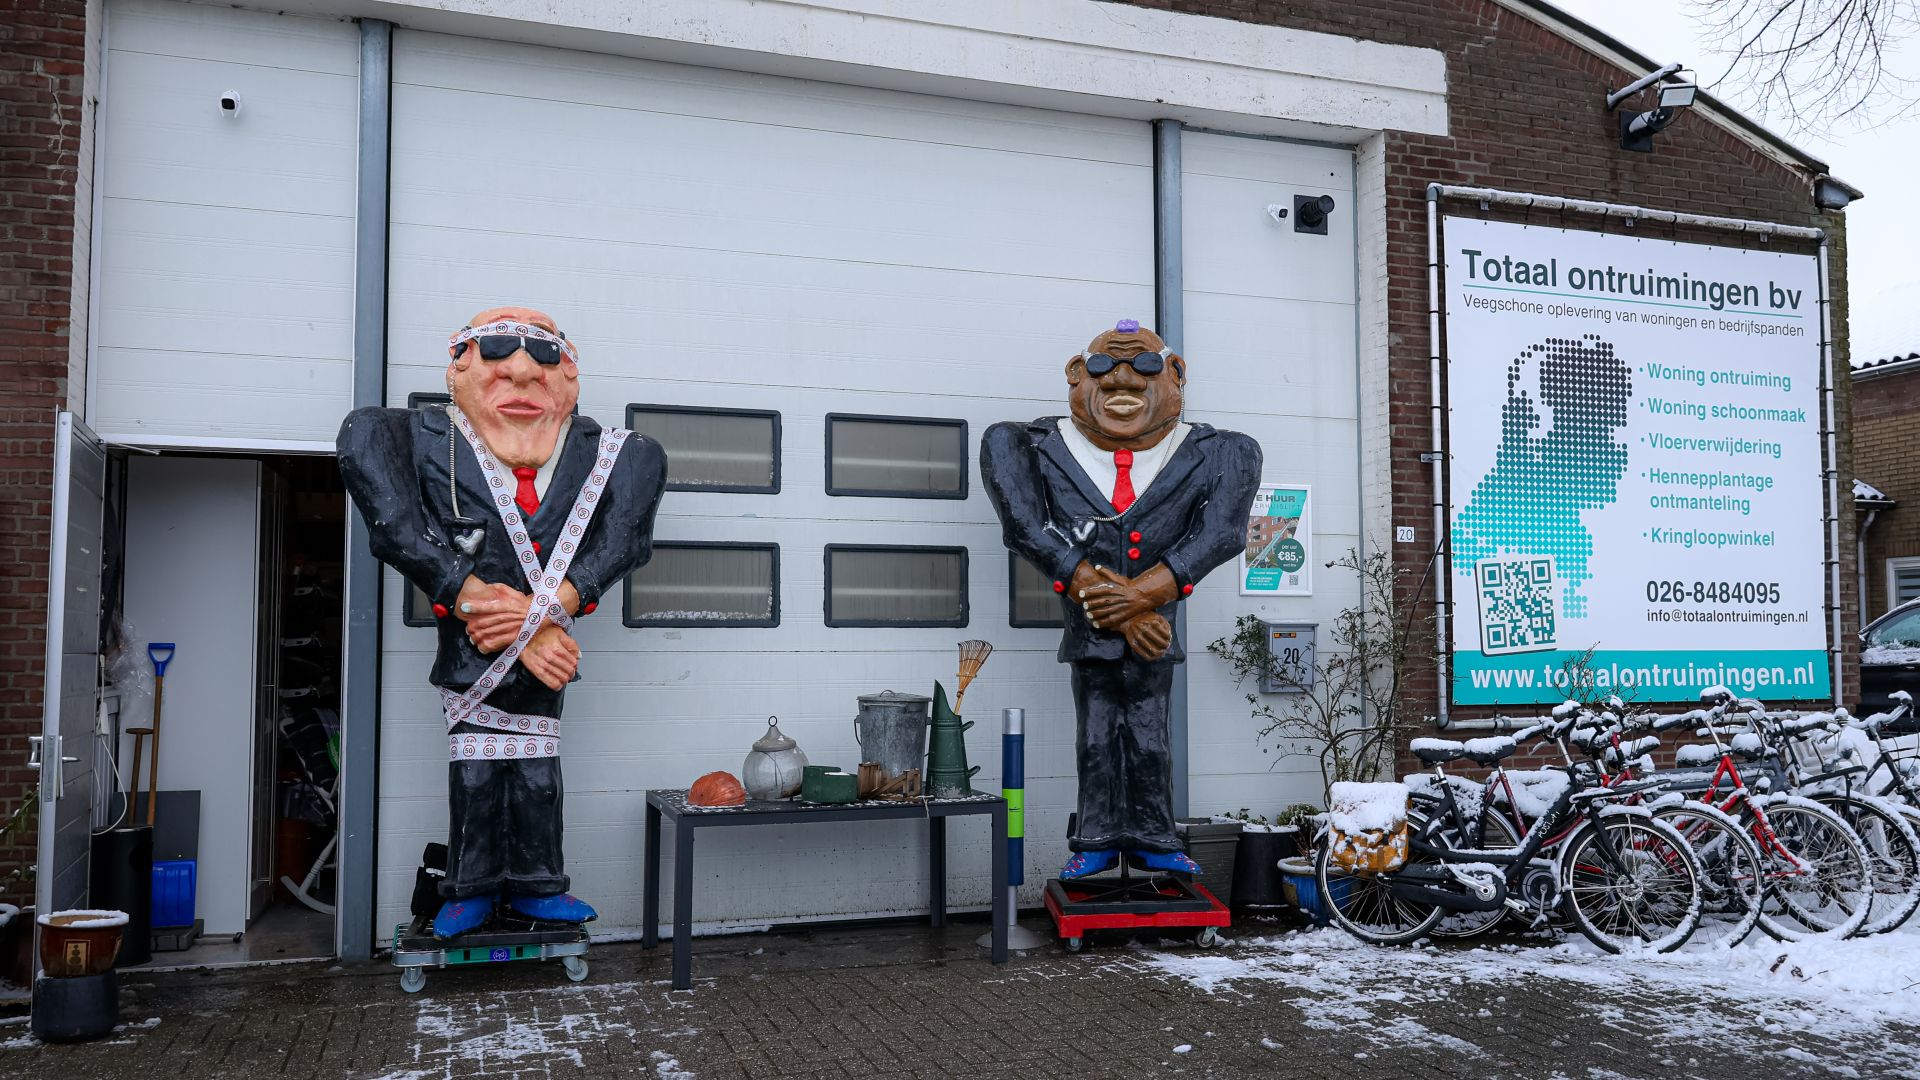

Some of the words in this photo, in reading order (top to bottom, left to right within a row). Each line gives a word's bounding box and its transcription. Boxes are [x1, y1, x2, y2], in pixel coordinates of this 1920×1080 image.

[1461, 248, 1557, 287] Totaal
[1568, 266, 1759, 311] ontruimingen
[1769, 281, 1802, 310] bv
[1463, 293, 1544, 314] Veegschone
[1547, 302, 1611, 324] oplevering
[1616, 312, 1637, 322] van
[1641, 312, 1697, 330] woningen
[1700, 318, 1716, 330] en
[1719, 318, 1804, 336] bedrijfspanden
[1647, 362, 1705, 386] Woning
[1710, 370, 1791, 392] ontruiming
[1648, 398, 1706, 420] Woning
[1711, 404, 1806, 422] schoonmaak
[1648, 432, 1782, 458] Vloerverwijdering
[1650, 468, 1774, 492] Hennepplantage
[1266, 494, 1296, 502] HUUR
[1650, 494, 1750, 515] ontmanteling
[1400, 529, 1412, 540] 20
[1651, 527, 1774, 548] Kringloopwinkel
[1278, 551, 1302, 562] €85,-
[1646, 580, 1780, 603] 026-8484095
[1647, 609, 1808, 625] info@totaalontruimingen.nl
[1284, 648, 1299, 664] 20
[1470, 662, 1814, 692] www.totaalontruimingen.nl
